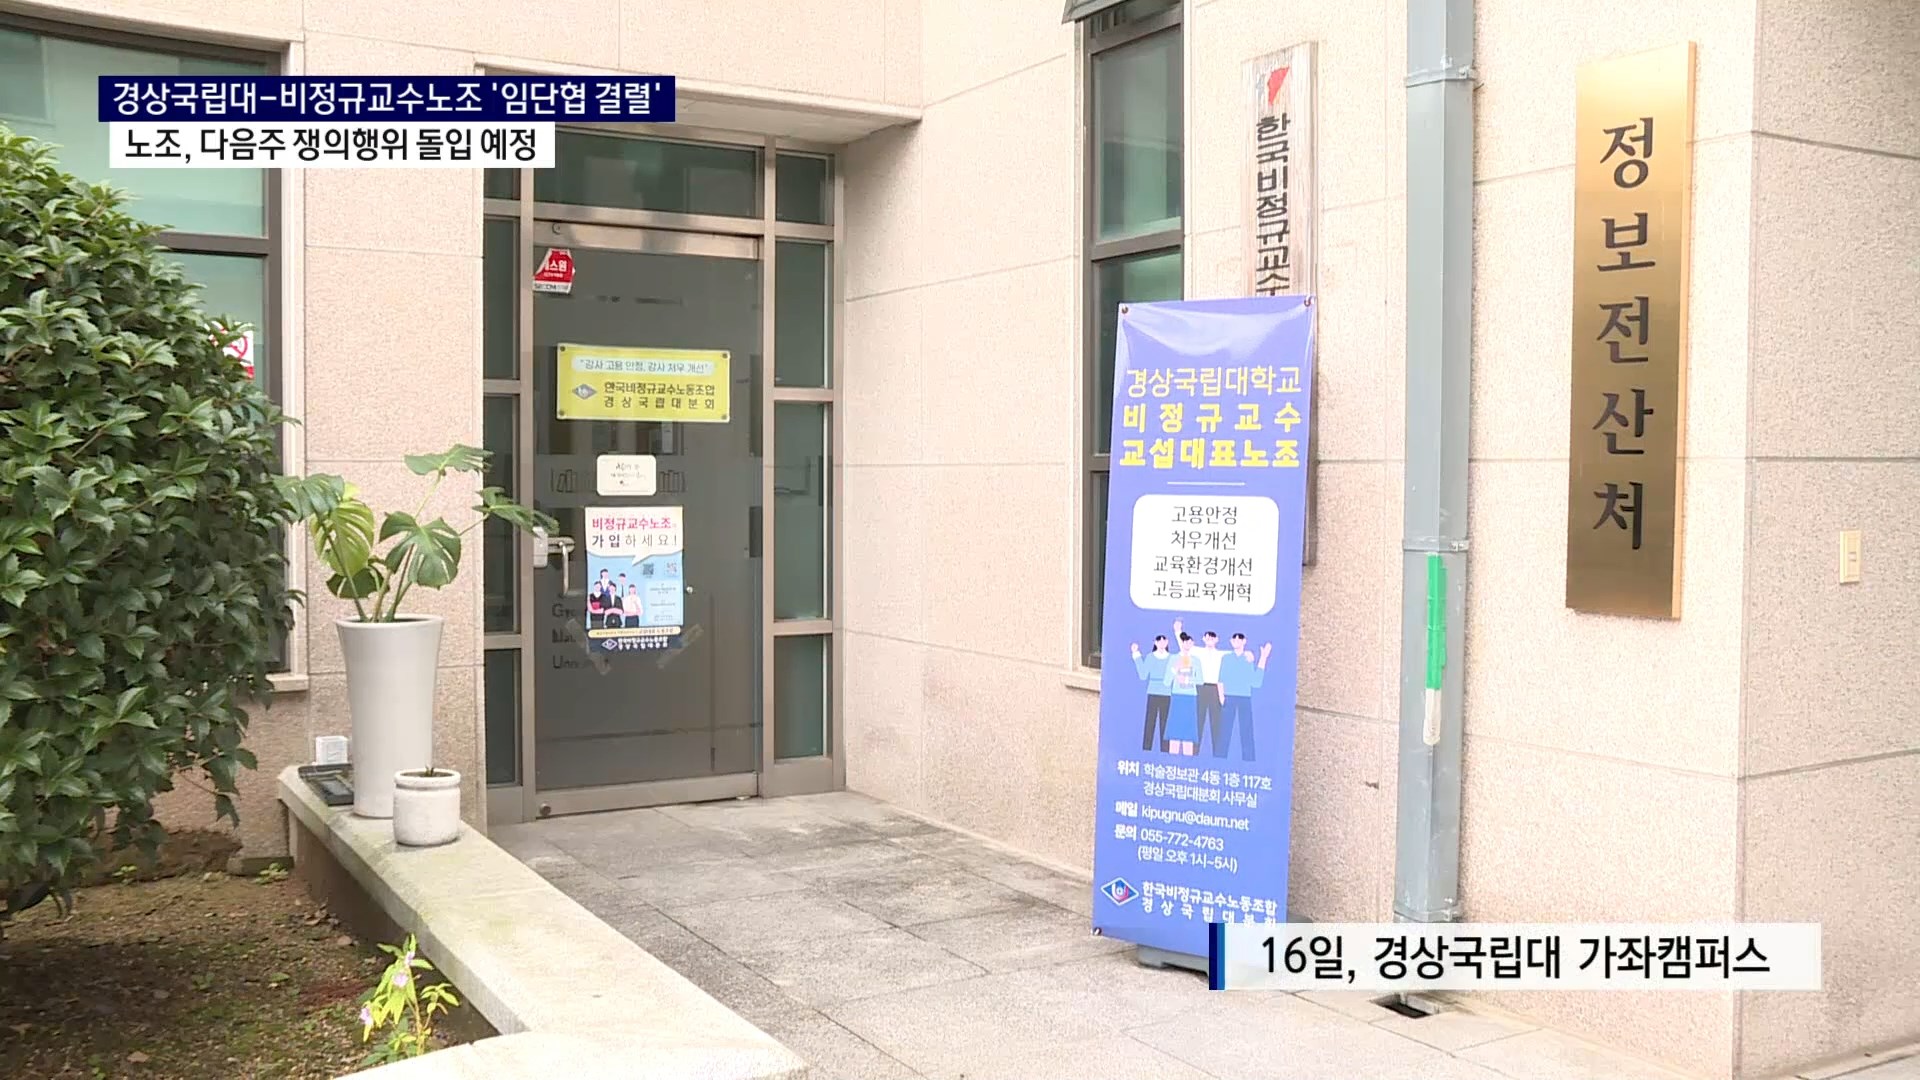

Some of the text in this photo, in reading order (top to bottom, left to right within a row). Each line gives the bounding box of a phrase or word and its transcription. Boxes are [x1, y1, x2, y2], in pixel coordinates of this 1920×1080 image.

[1592, 115, 1656, 551] 정보전산처
[1127, 365, 1302, 398] 경상국립대학교
[1119, 437, 1301, 470] 교섭대표노조
[1171, 506, 1239, 526] 고용안정
[1170, 530, 1237, 551] 처우개선
[1153, 555, 1253, 577] 교육환경개선
[1152, 580, 1252, 603] 고등교육개혁
[1117, 760, 1273, 791] 위치 학술정보관 4동 1층 117호
[1143, 782, 1258, 808] 경상국립대분회 사무실
[1115, 801, 1250, 832] 메일 kipugnu@daum.net
[1114, 824, 1225, 851] 문의 055-772-4763
[1138, 844, 1238, 873] (평일 오후 1시~5시)
[1142, 881, 1278, 916] 한국비정규교수노동조합
